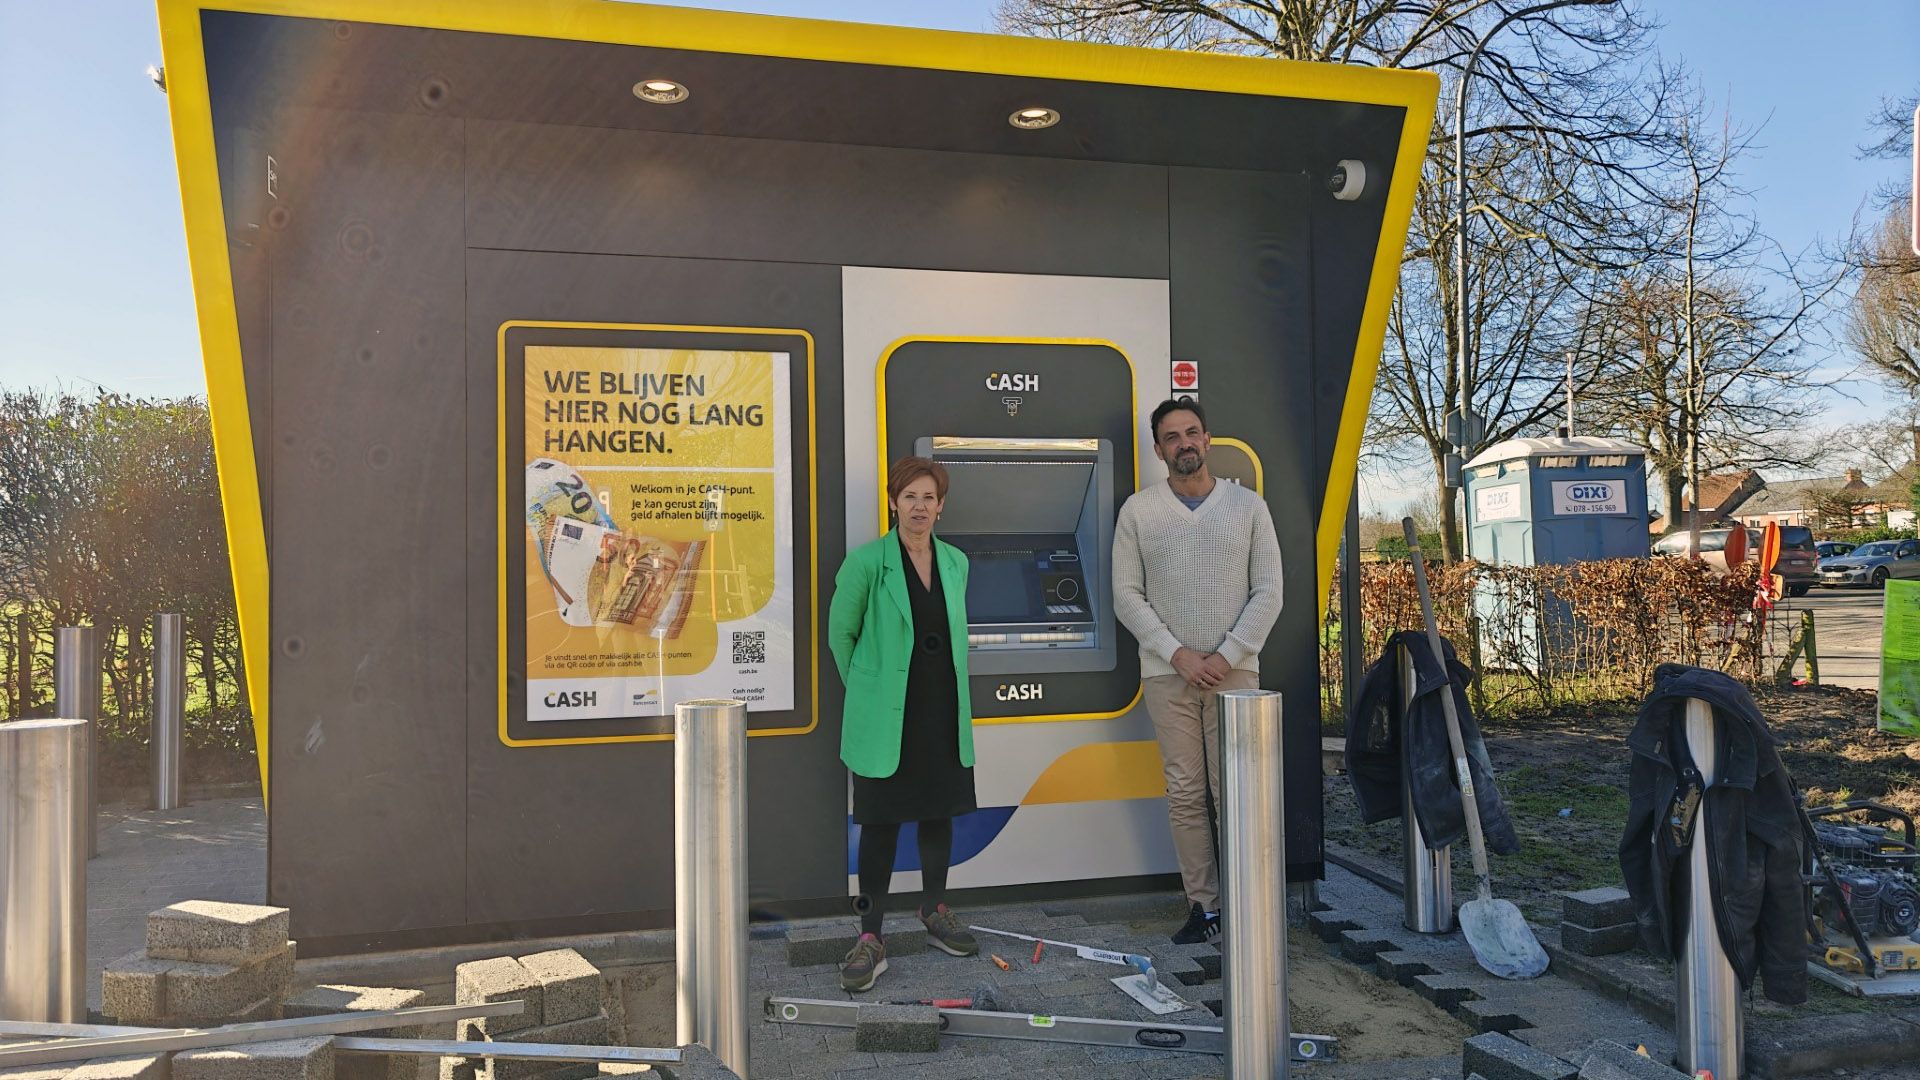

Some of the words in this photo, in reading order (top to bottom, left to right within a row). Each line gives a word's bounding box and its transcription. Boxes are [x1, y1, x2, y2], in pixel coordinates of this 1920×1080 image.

[544, 370, 590, 393] WE
[600, 372, 705, 400] BLIJVEN
[985, 373, 1039, 391] CASH
[544, 400, 609, 423] HIER
[618, 402, 680, 424] NOG
[689, 405, 764, 426] LANG
[544, 430, 673, 454] HANGEN.
[630, 485, 672, 494] Welkom
[675, 485, 684, 494] in
[687, 485, 696, 496] je
[699, 485, 755, 496] CASH-punt.
[632, 500, 641, 511] Je
[644, 500, 662, 509] kan
[665, 501, 696, 511] gerust
[699, 500, 718, 511] zijn,
[631, 511, 652, 521] geld
[655, 511, 692, 520] afhalen
[695, 511, 718, 521] blijft
[720, 511, 765, 521] mogelijk.
[544, 691, 597, 708] CASH
[995, 683, 1043, 701] CASH
